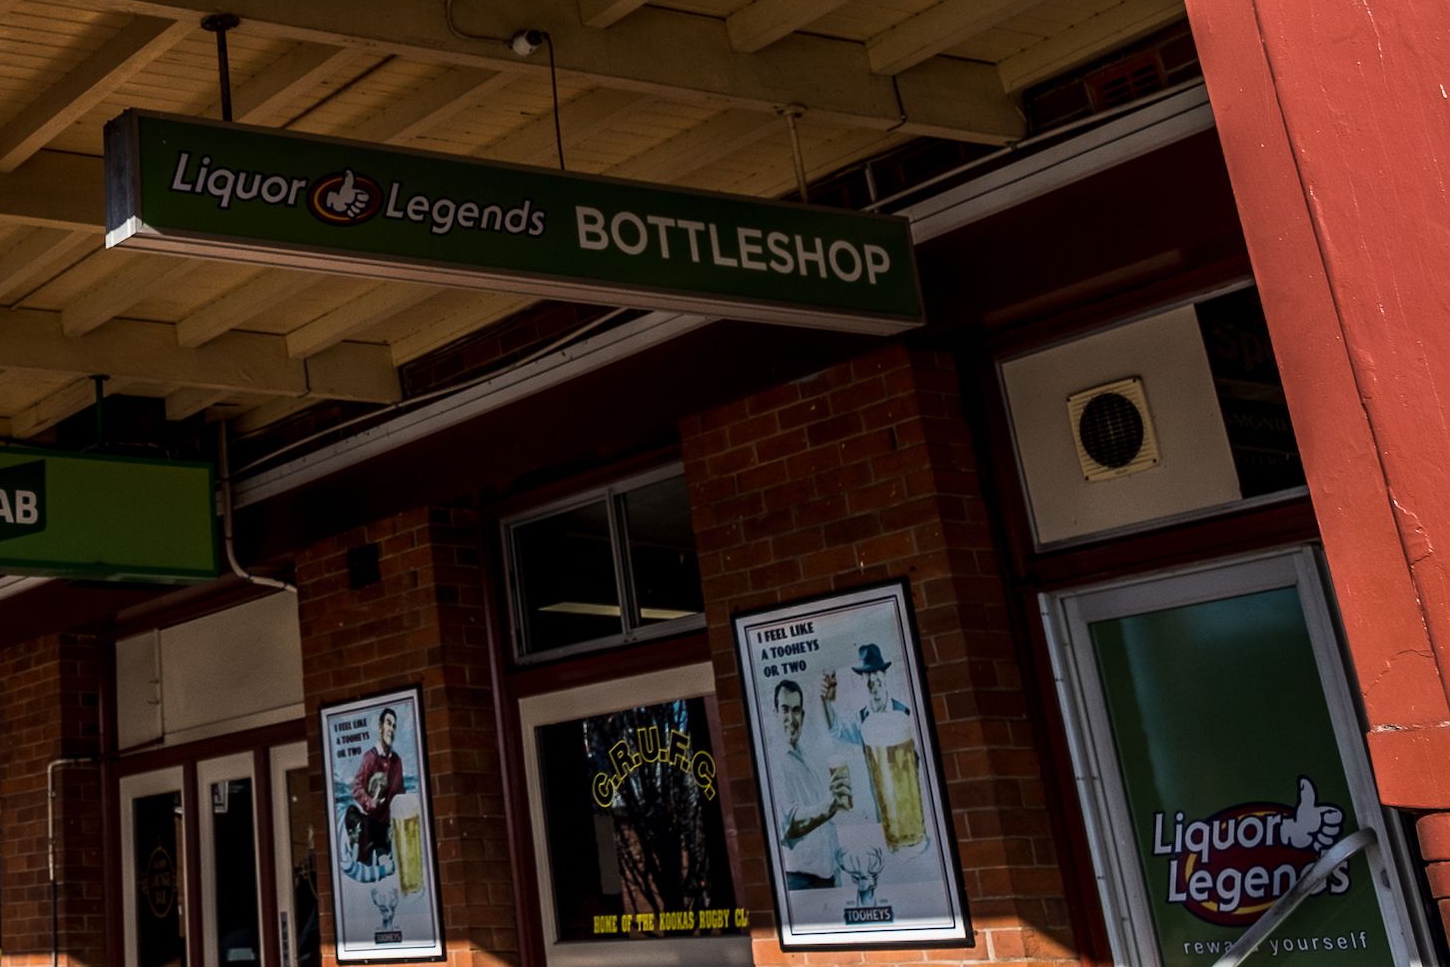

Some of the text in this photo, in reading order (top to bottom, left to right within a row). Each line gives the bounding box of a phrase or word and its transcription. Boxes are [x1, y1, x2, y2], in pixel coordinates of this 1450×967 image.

[172, 152, 890, 284] Liquor Legends BOTTLESHOP
[757, 622, 814, 644] I FEEL LIKE
[761, 639, 819, 660] A TOOHEYS
[764, 660, 806, 678] OR TWO
[1154, 812, 1281, 863] Liquor
[593, 908, 749, 933] HOME OF THE KOOKAS RUGBY CL
[847, 908, 891, 922] TOOHEYS
[1184, 931, 1367, 956] rewa yourself
